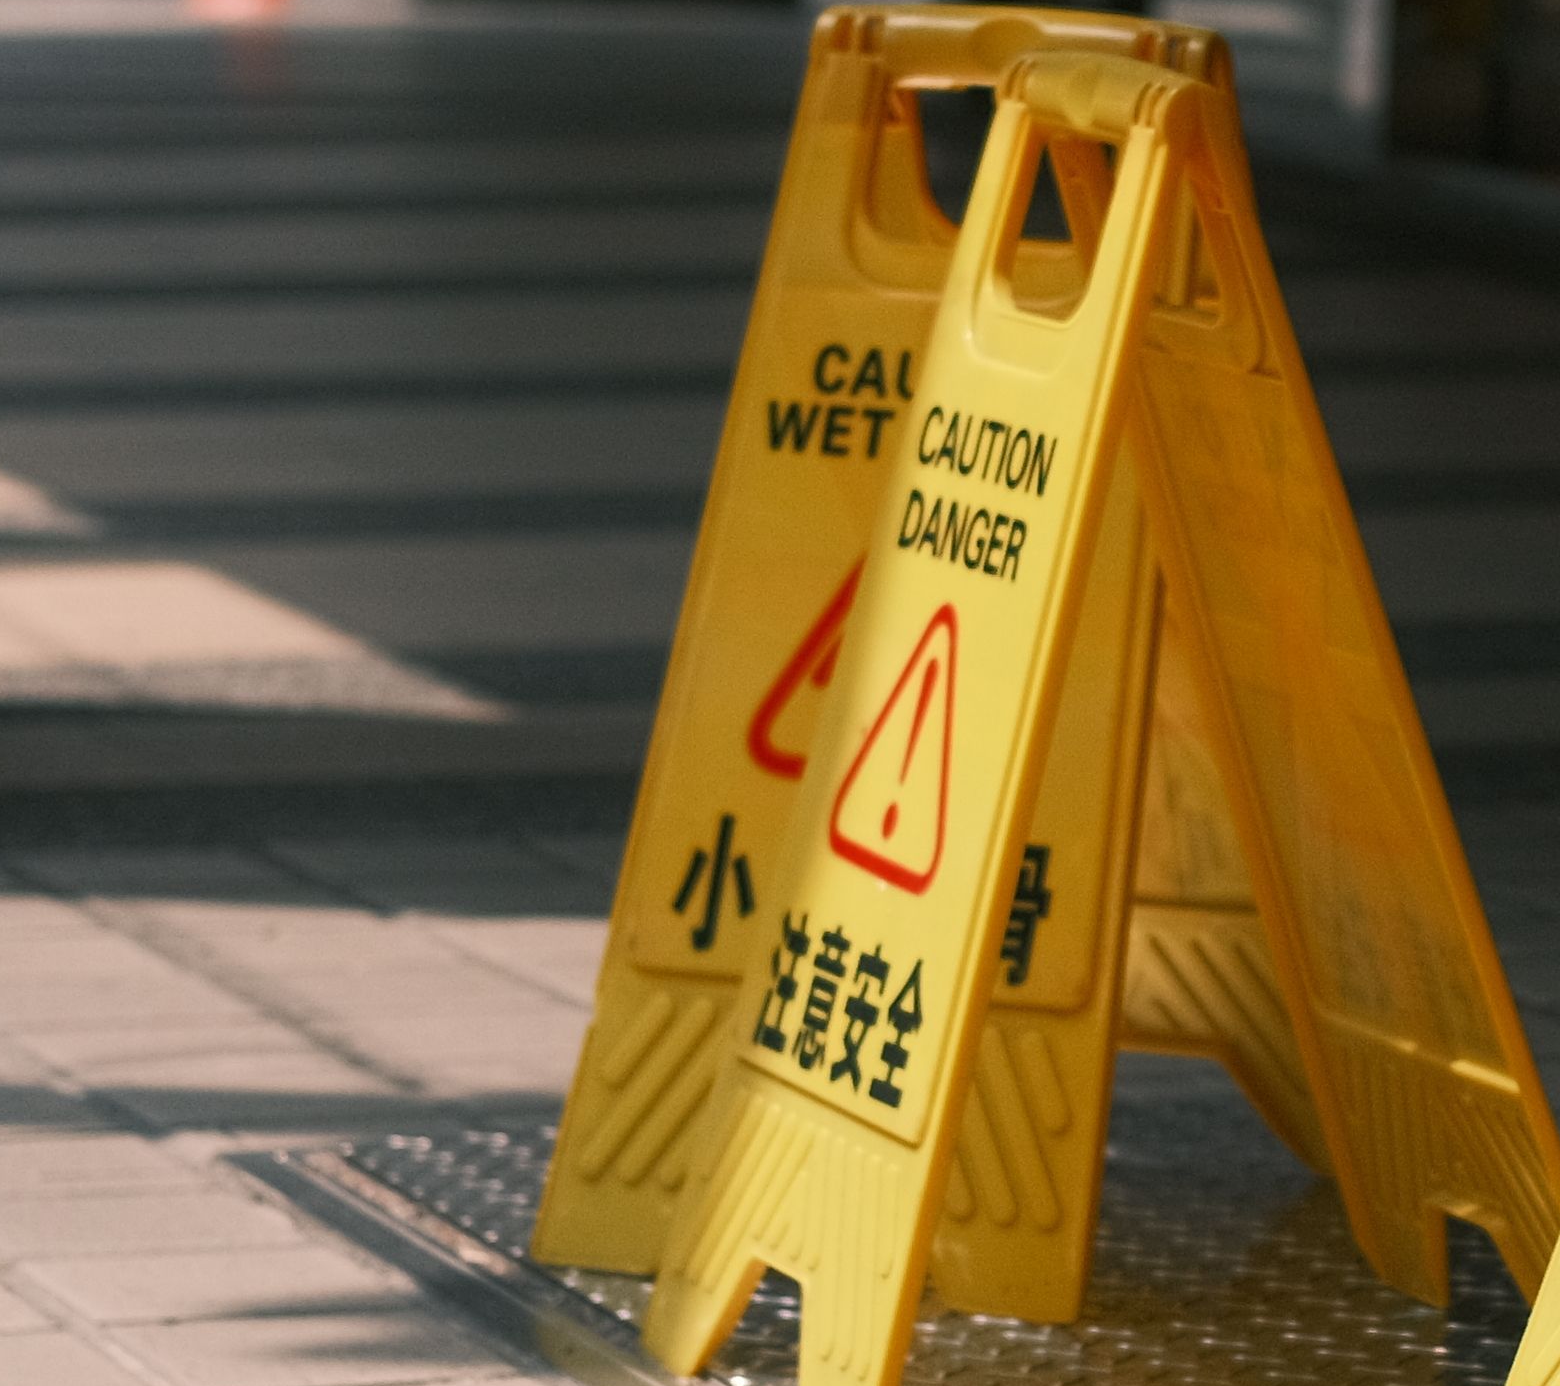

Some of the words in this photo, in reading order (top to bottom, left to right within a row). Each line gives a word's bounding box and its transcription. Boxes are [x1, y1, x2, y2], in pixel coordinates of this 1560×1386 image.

[768, 400, 897, 459] WET
[918, 405, 1058, 497] CAUTION
[897, 488, 1026, 582] DANGER
[753, 910, 923, 1109] 注意安全
